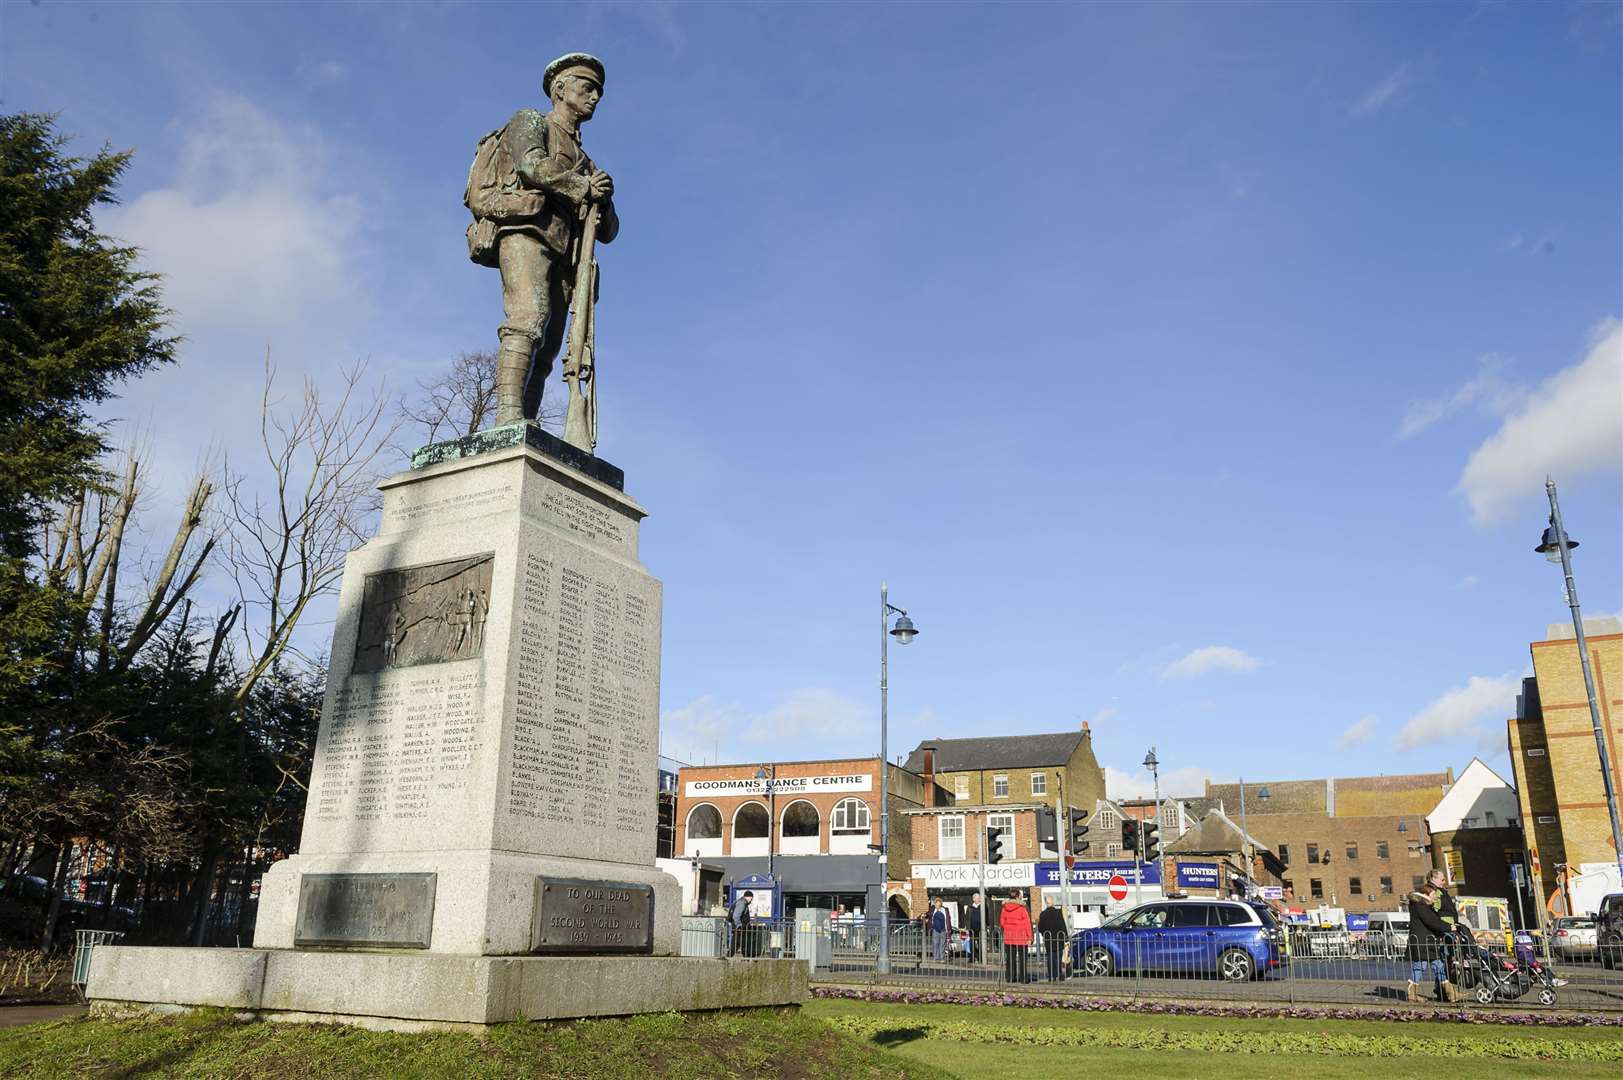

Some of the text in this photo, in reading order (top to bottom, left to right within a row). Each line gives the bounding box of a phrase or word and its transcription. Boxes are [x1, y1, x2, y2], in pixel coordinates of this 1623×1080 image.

[694, 776, 863, 790] GOODMANS DANCE CENTRE
[929, 865, 1030, 880] Mark Mardell
[568, 888, 631, 902] TO OUR DEAD
[582, 903, 616, 914] OF THE
[551, 917, 641, 930] SECOND WORLD WAR
[604, 932, 623, 944] 1945
